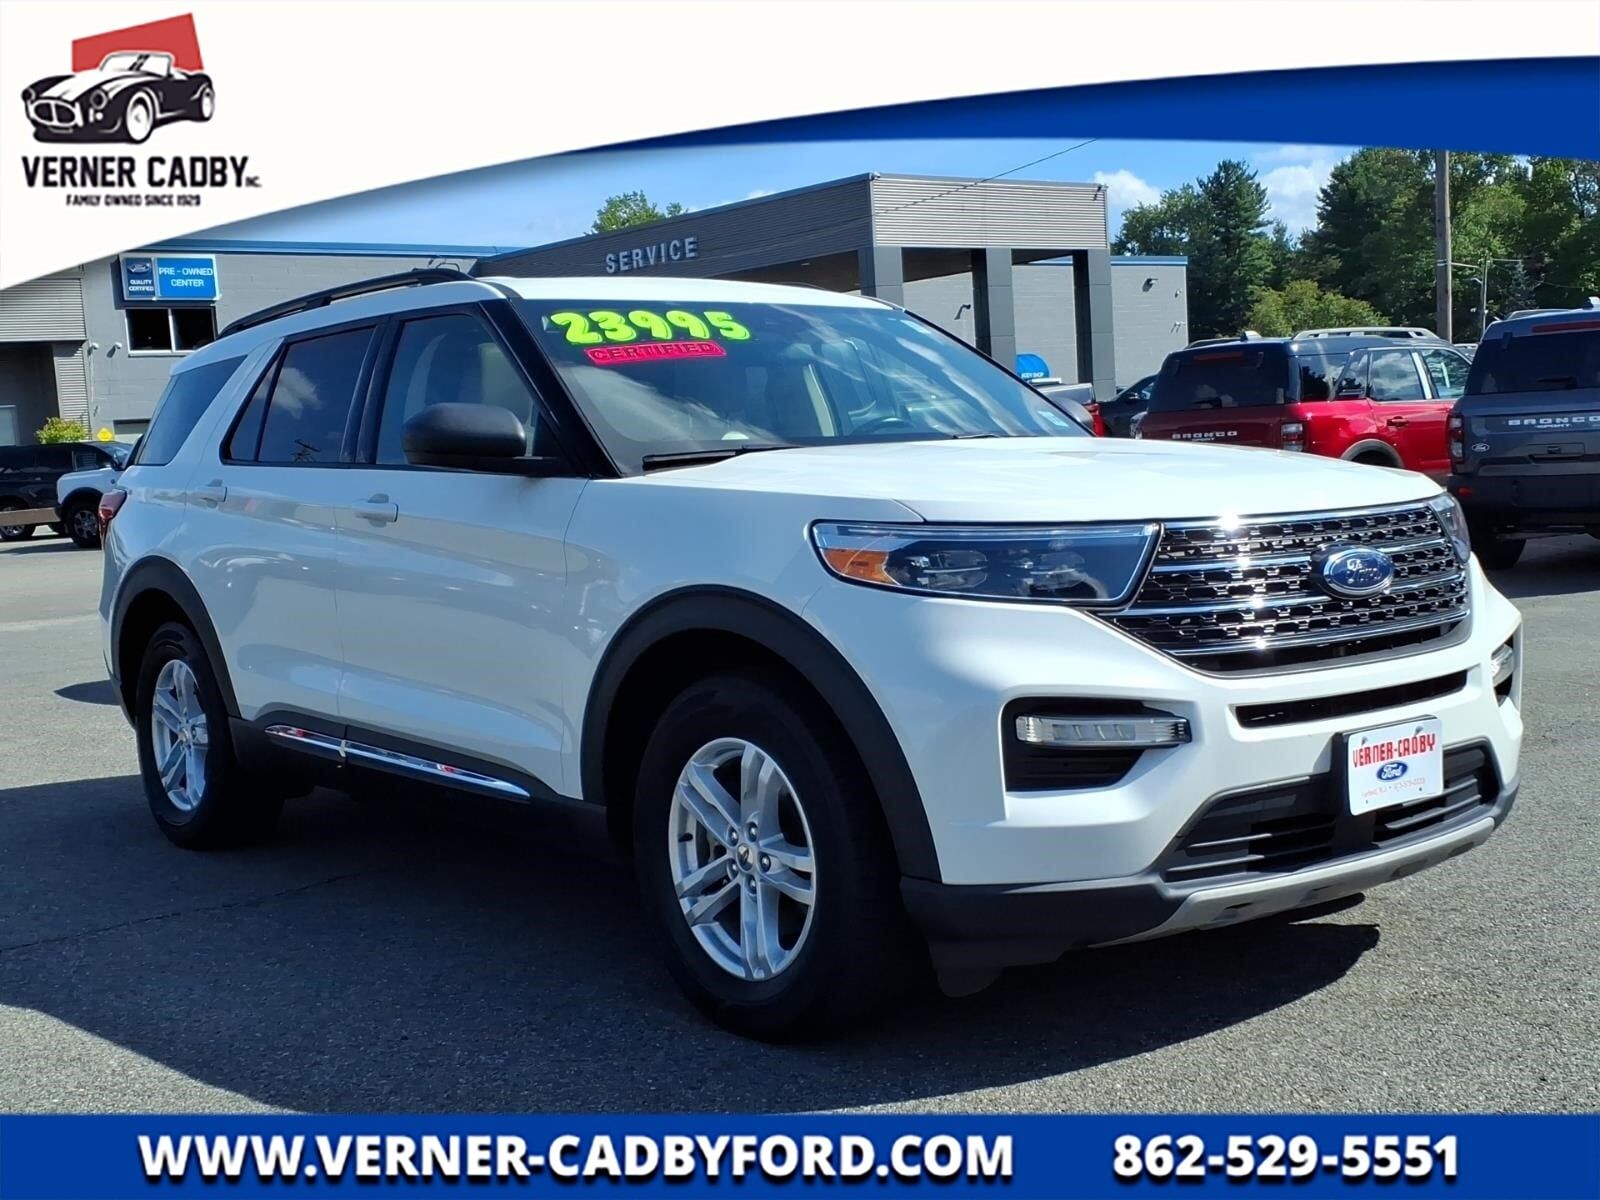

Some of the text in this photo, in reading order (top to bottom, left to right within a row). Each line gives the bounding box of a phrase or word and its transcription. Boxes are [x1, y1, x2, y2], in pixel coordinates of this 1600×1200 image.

[605, 236, 698, 274] SERVICE
[158, 267, 176, 276] PRE
[182, 267, 213, 276] OWNED
[170, 278, 205, 287] CENTER
[550, 310, 751, 345] 23995
[590, 343, 718, 361] CERTIFIED
[1508, 416, 1600, 425] BRONCO
[1171, 430, 1238, 440] BRONCO
[1352, 733, 1436, 768] VERNER-CADBY
[1380, 763, 1403, 780] Ford
